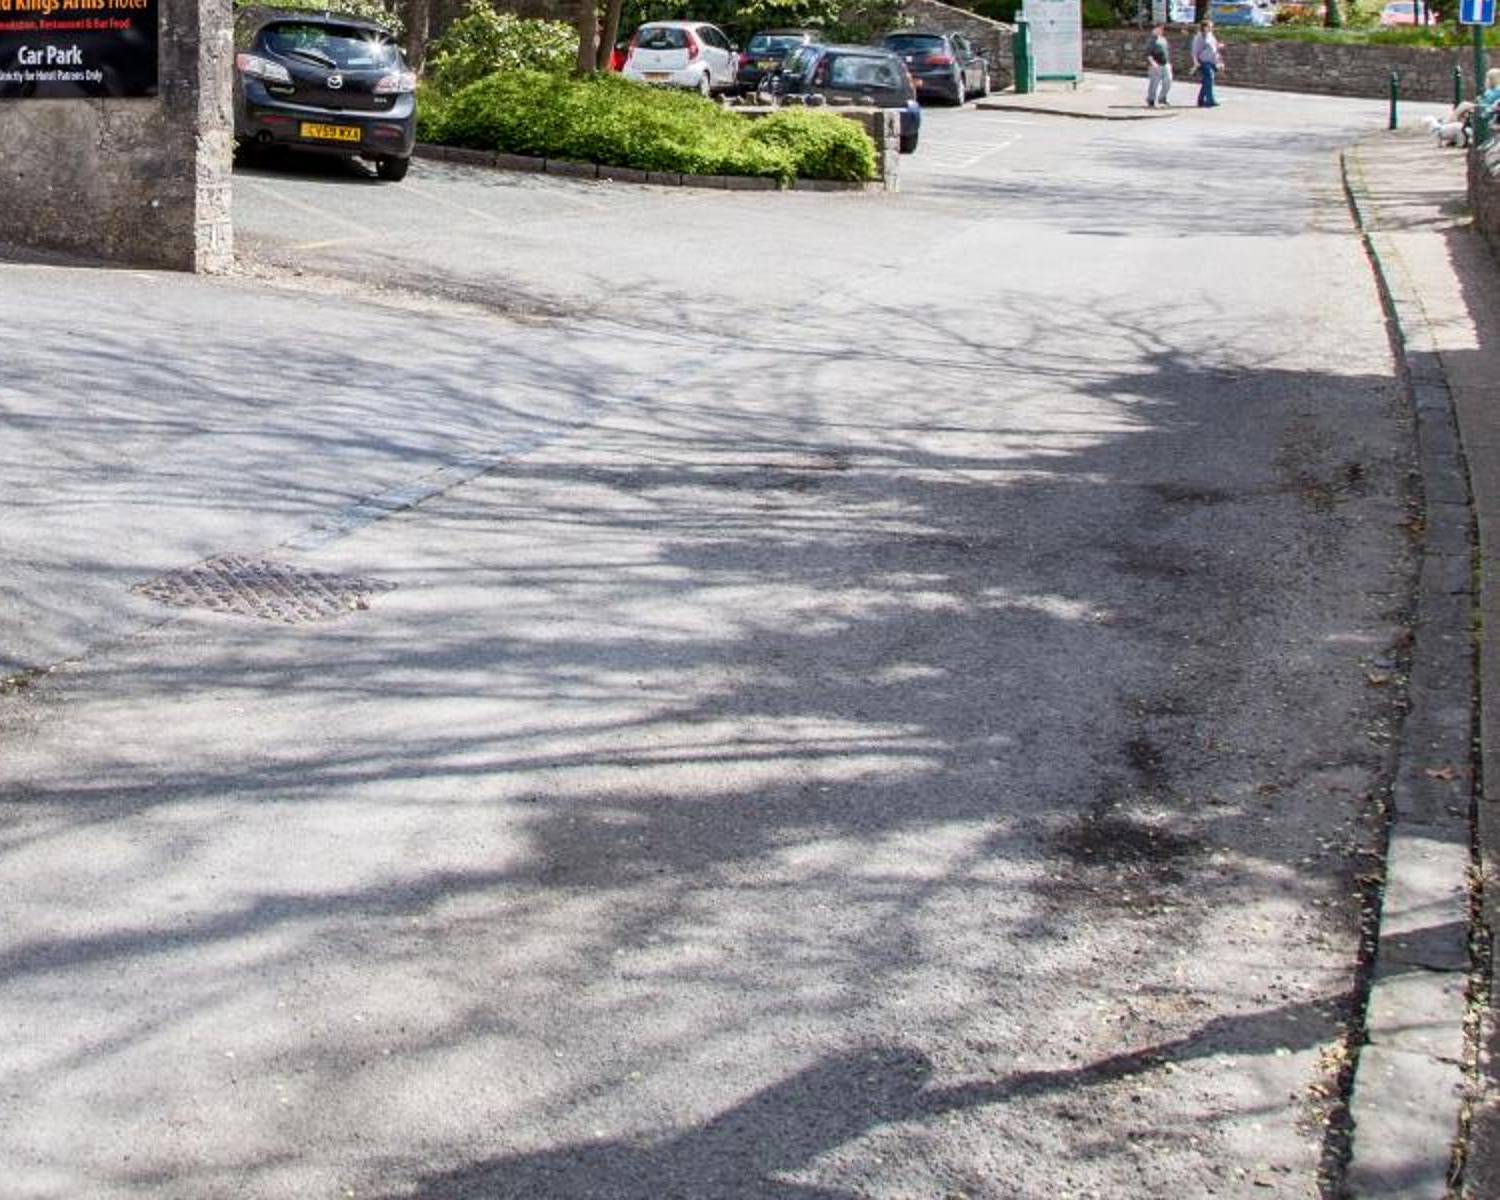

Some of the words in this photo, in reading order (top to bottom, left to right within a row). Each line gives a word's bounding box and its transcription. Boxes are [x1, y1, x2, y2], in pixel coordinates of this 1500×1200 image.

[18, 45, 44, 65] Car
[47, 44, 83, 65] Park
[85, 69, 103, 84] Only
